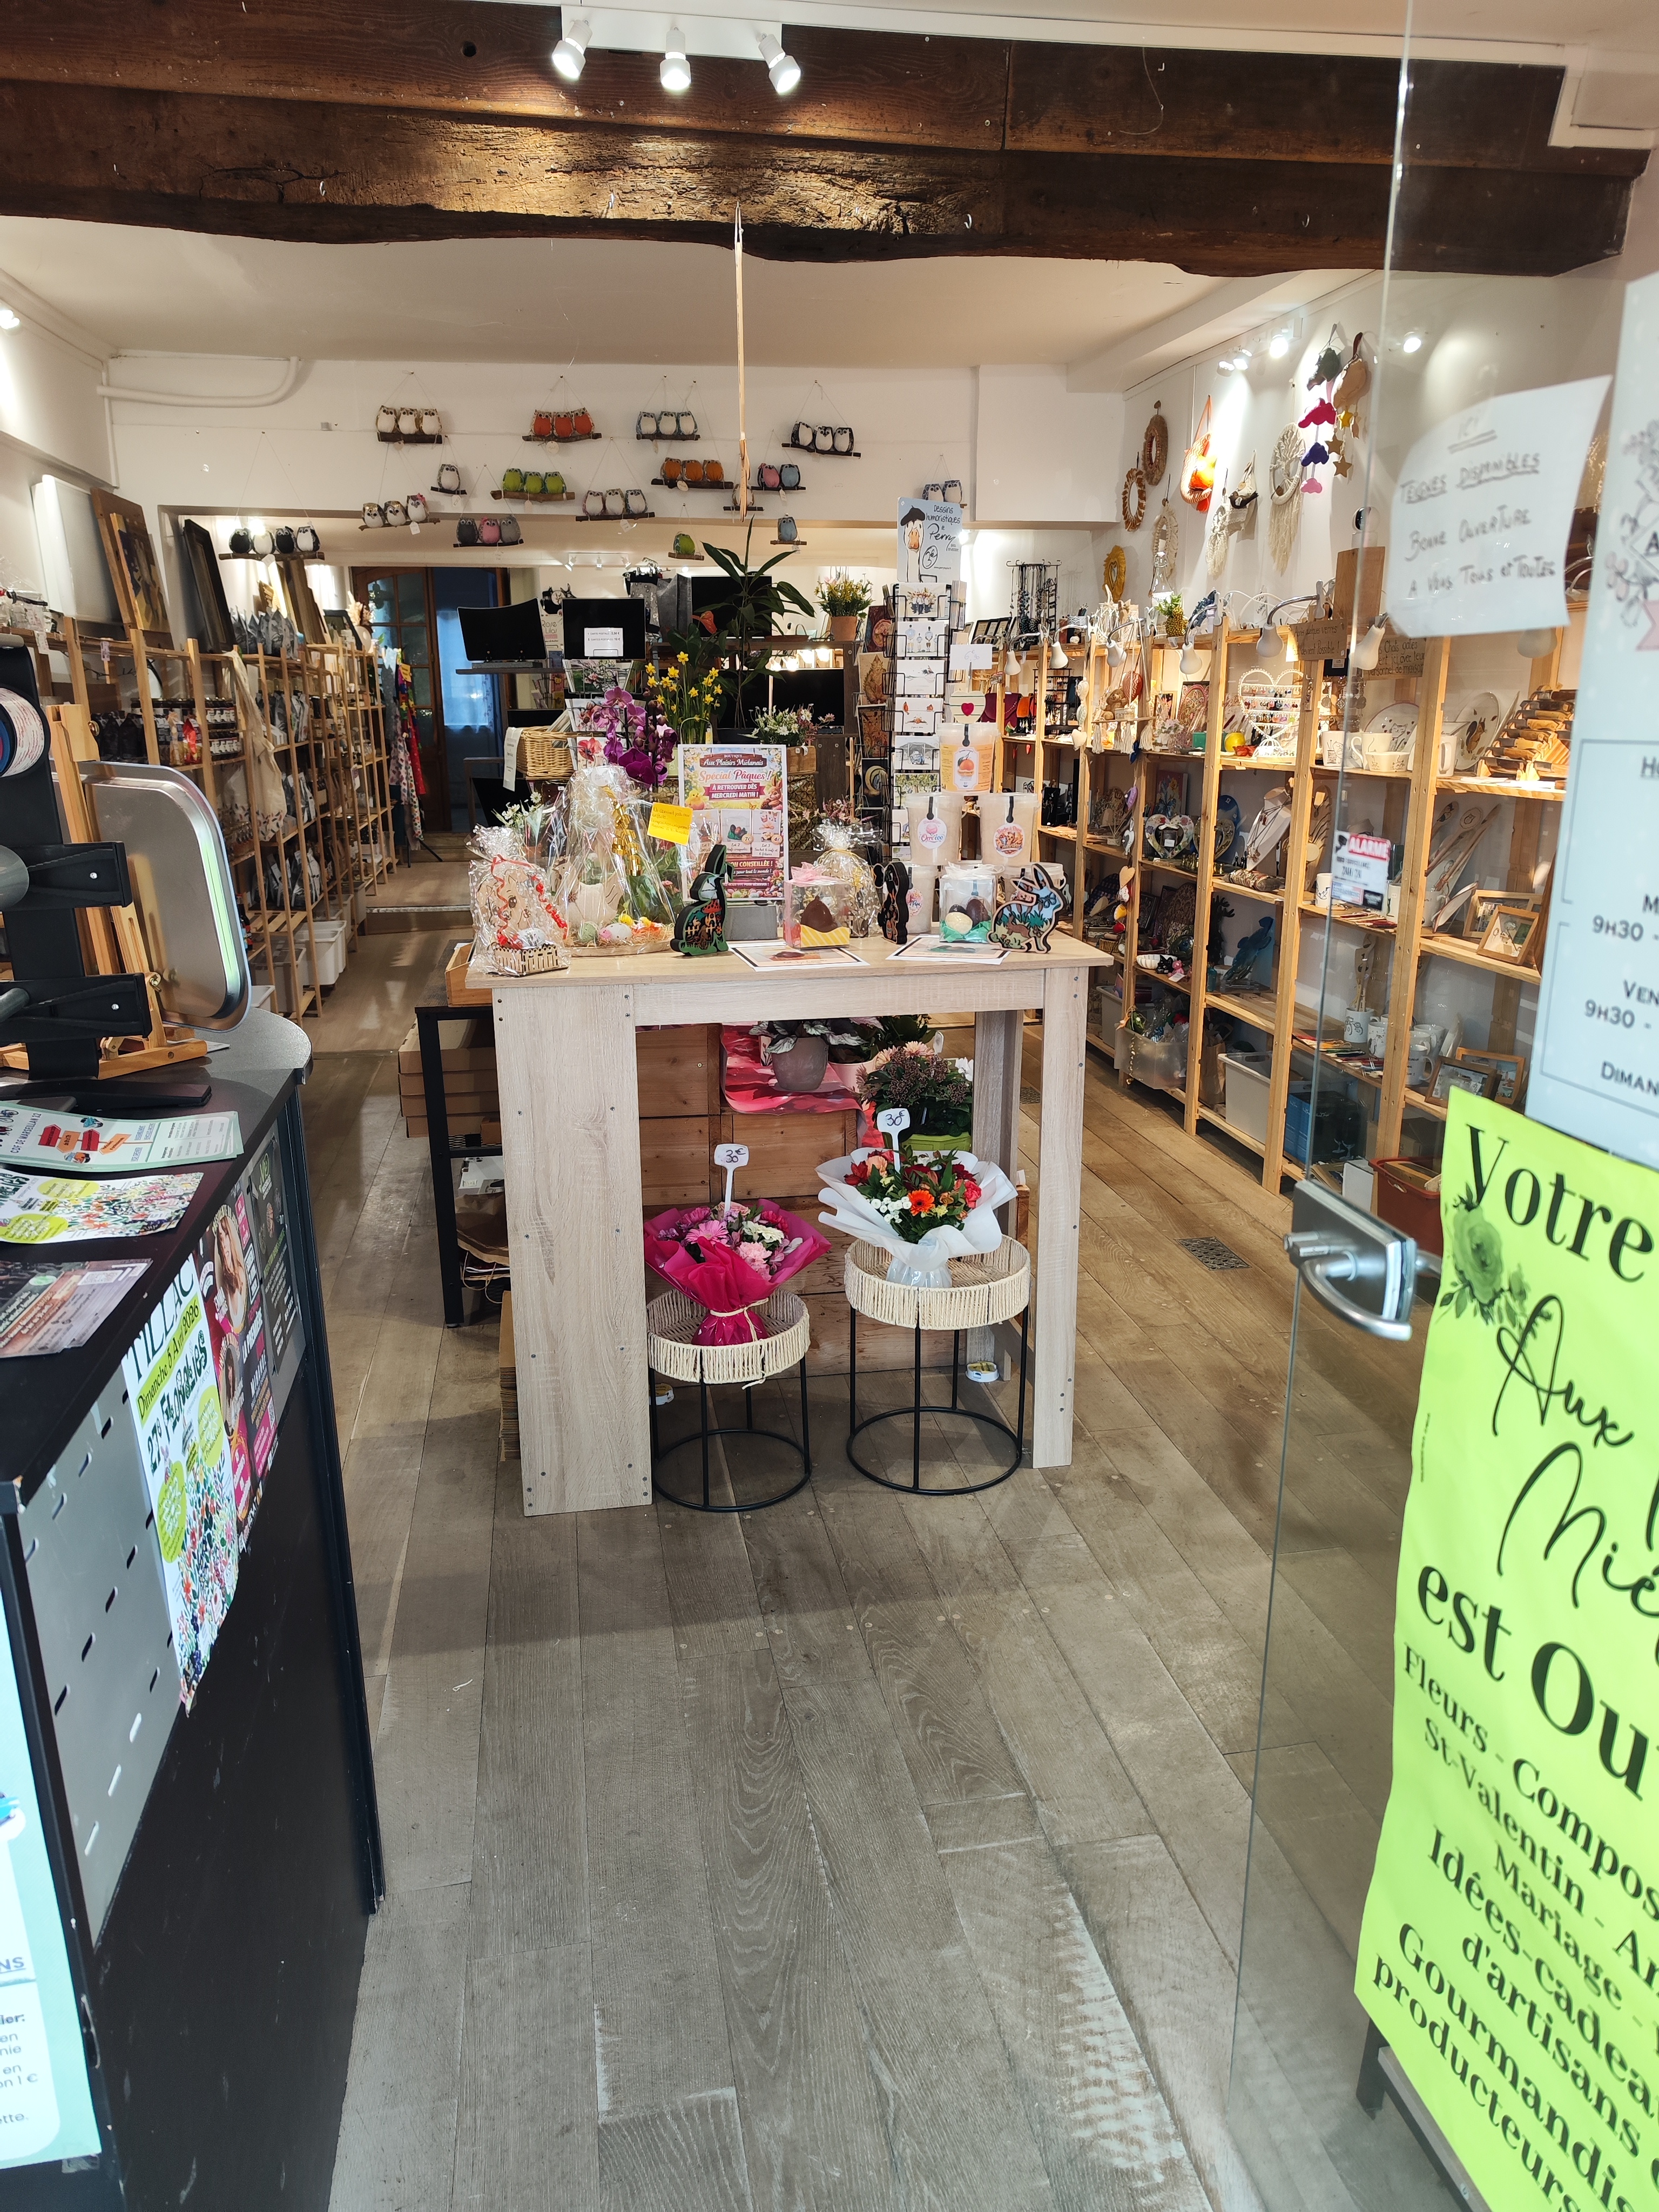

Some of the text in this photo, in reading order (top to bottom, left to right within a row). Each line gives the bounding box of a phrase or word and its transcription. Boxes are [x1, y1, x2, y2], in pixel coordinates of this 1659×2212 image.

[926, 512, 960, 525] humoristiques
[934, 504, 954, 514] Dessins
[927, 523, 956, 551] Perry
[1384, 639, 1399, 653] Chats
[1395, 663, 1402, 673] de
[698, 769, 772, 783] Spécial Pâques !
[703, 758, 716, 766] Aux
[739, 859, 770, 867] CONSEILLÉE
[1593, 914, 1644, 942] 9H30
[1584, 999, 1635, 1028] 9H30
[885, 1109, 906, 1127] 30€
[725, 1148, 746, 1163] 30€
[1465, 1123, 1655, 1283] Votre
[126, 1259, 194, 1384] TILLAC
[137, 1362, 168, 1421] Dimanche
[166, 1346, 172, 1369] 5
[182, 1299, 199, 1336] 2026
[1492, 1293, 1635, 1448] Aux
[1418, 1565, 1512, 1682] est
[1403, 1642, 1489, 1754] Fleurs
[1530, 1641, 1643, 1802] Ou
[1424, 1717, 1585, 1917] St-Valentin
[1494, 1842, 1623, 2011] Mariage
[1427, 1823, 1659, 2120] Idées-cadea
[1461, 1933, 1641, 2159] d'artisans
